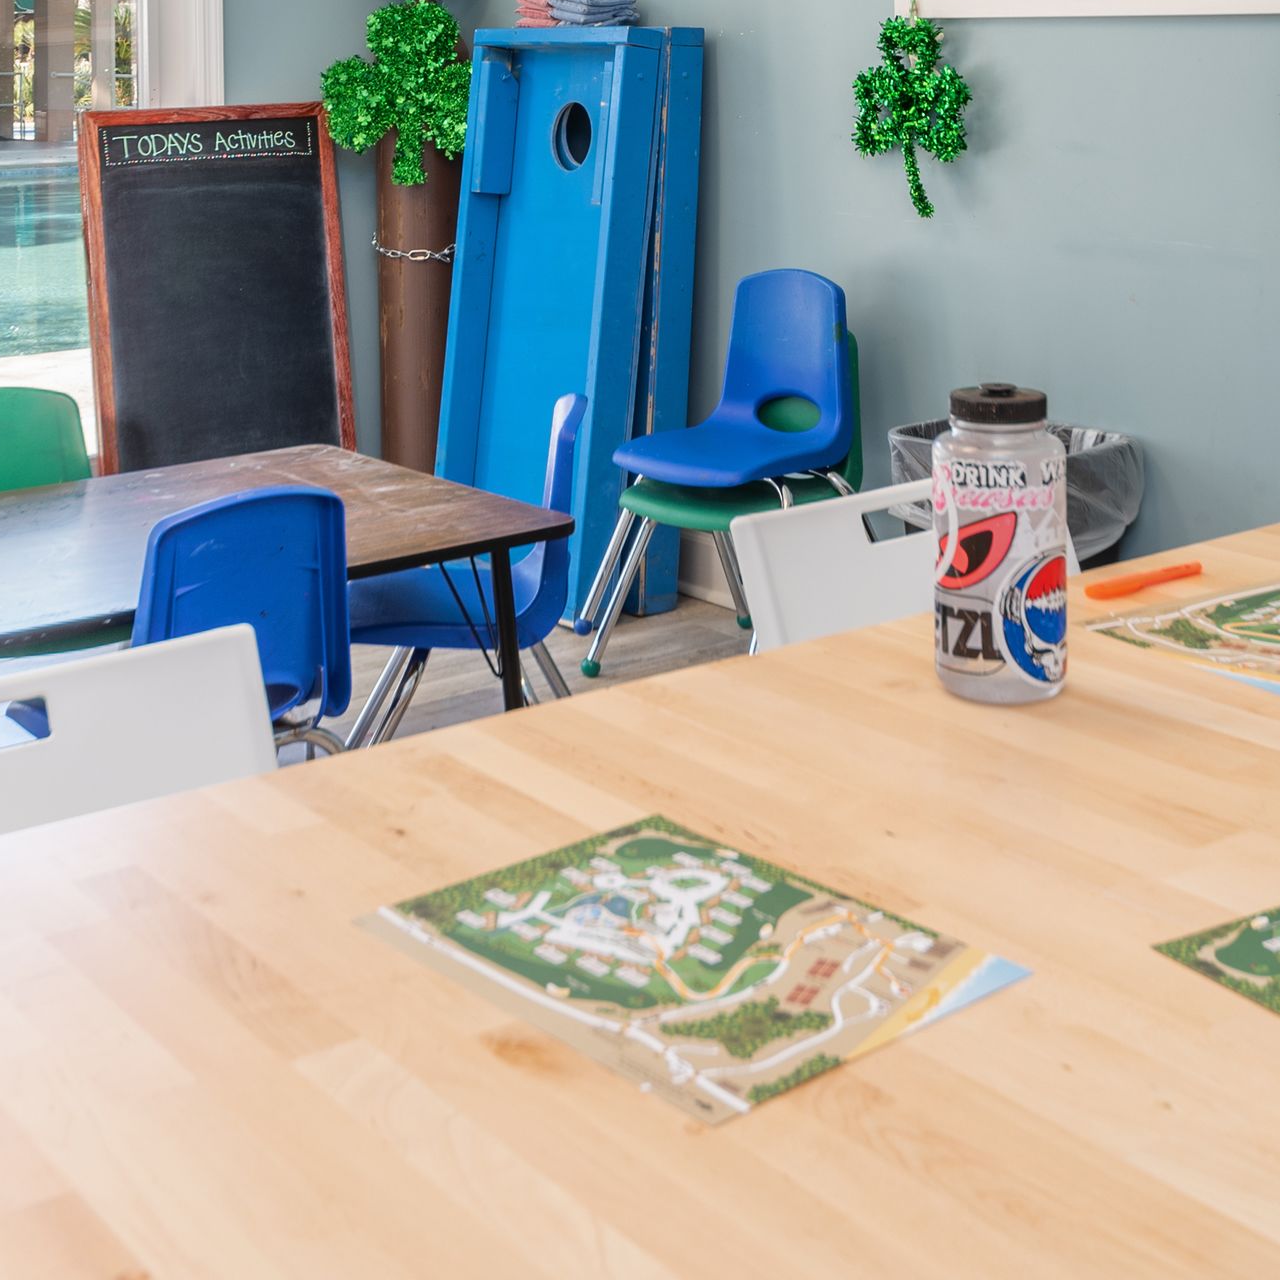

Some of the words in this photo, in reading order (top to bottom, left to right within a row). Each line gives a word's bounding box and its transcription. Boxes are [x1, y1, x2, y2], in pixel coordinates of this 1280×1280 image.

[112, 132, 203, 158] TODAYS
[215, 129, 296, 151] Activities
[951, 461, 1027, 488] DRINK
